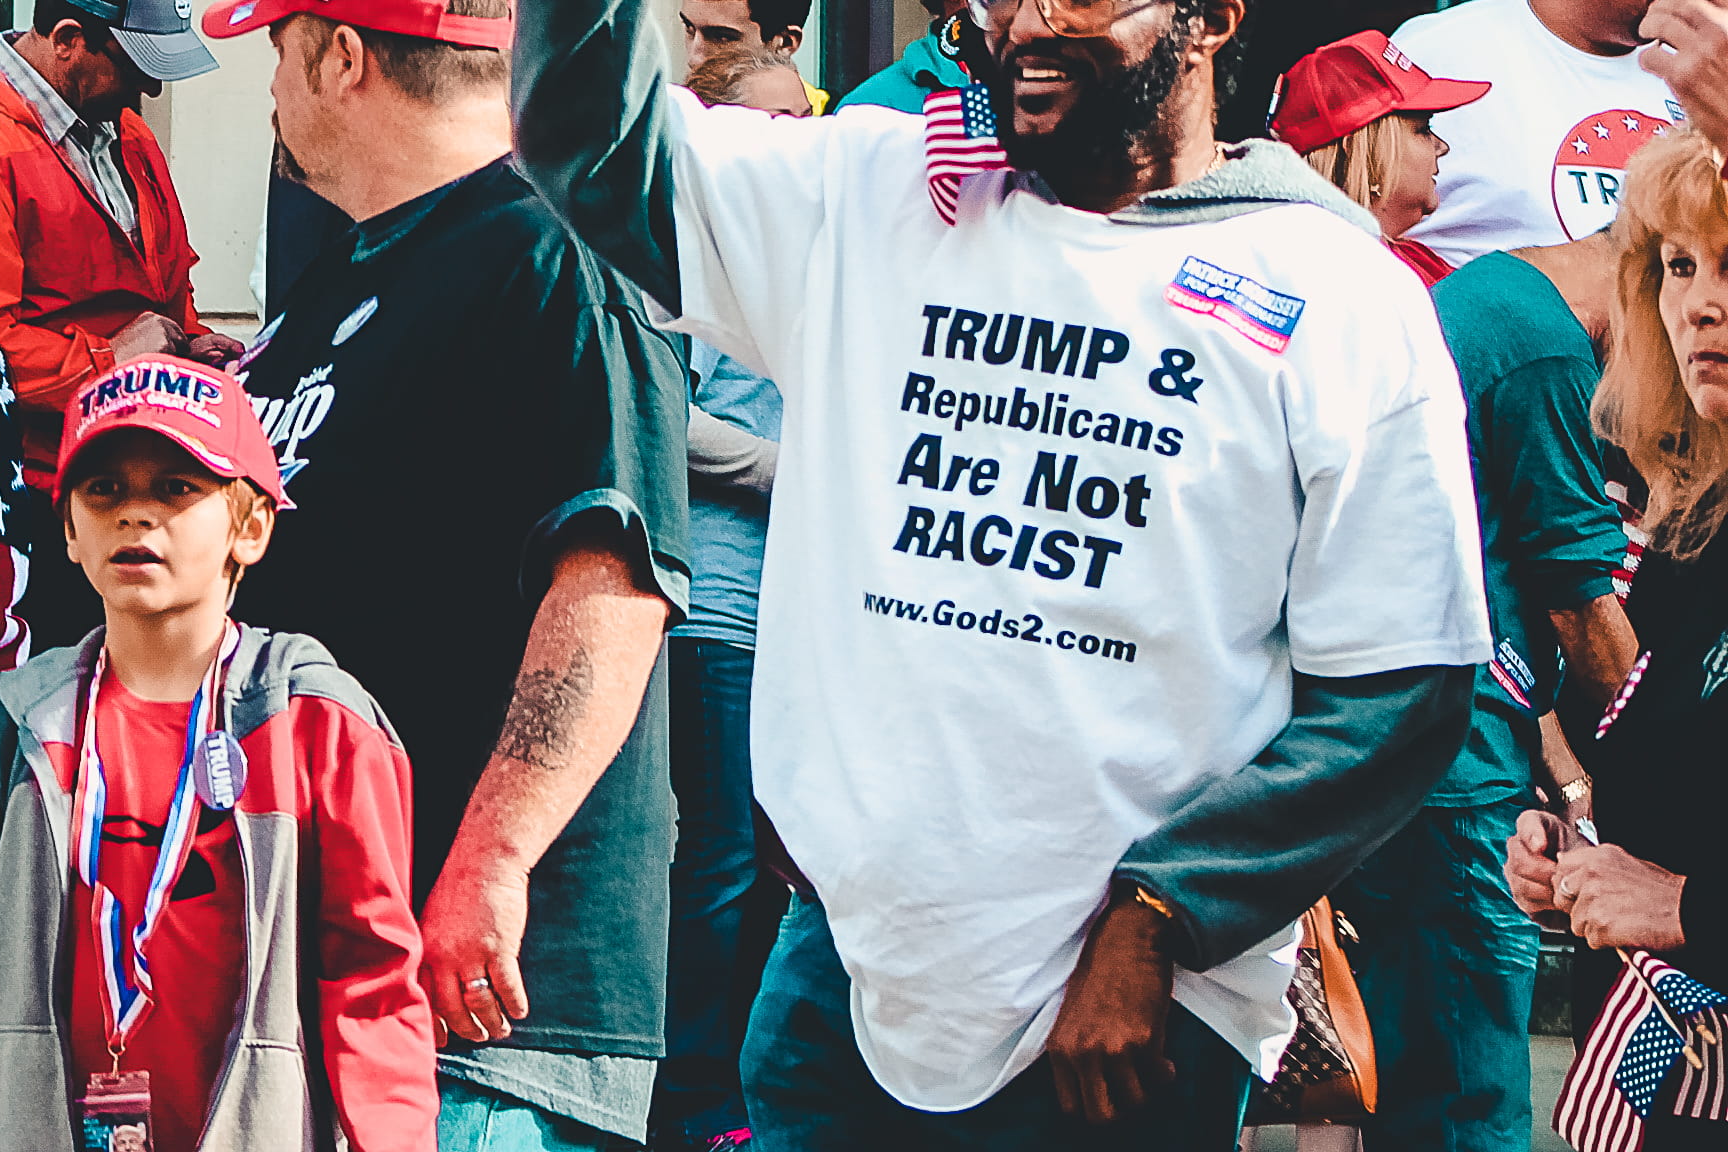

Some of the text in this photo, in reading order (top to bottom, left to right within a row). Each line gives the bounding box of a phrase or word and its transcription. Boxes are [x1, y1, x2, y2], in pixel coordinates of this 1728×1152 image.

[79, 368, 224, 418] TRUMP
[921, 304, 1205, 404] TRUMP &
[900, 371, 1185, 457] Republicans
[897, 432, 1153, 529] Are Not
[892, 505, 1123, 589] RACIST
[208, 731, 235, 809] TRUMP
